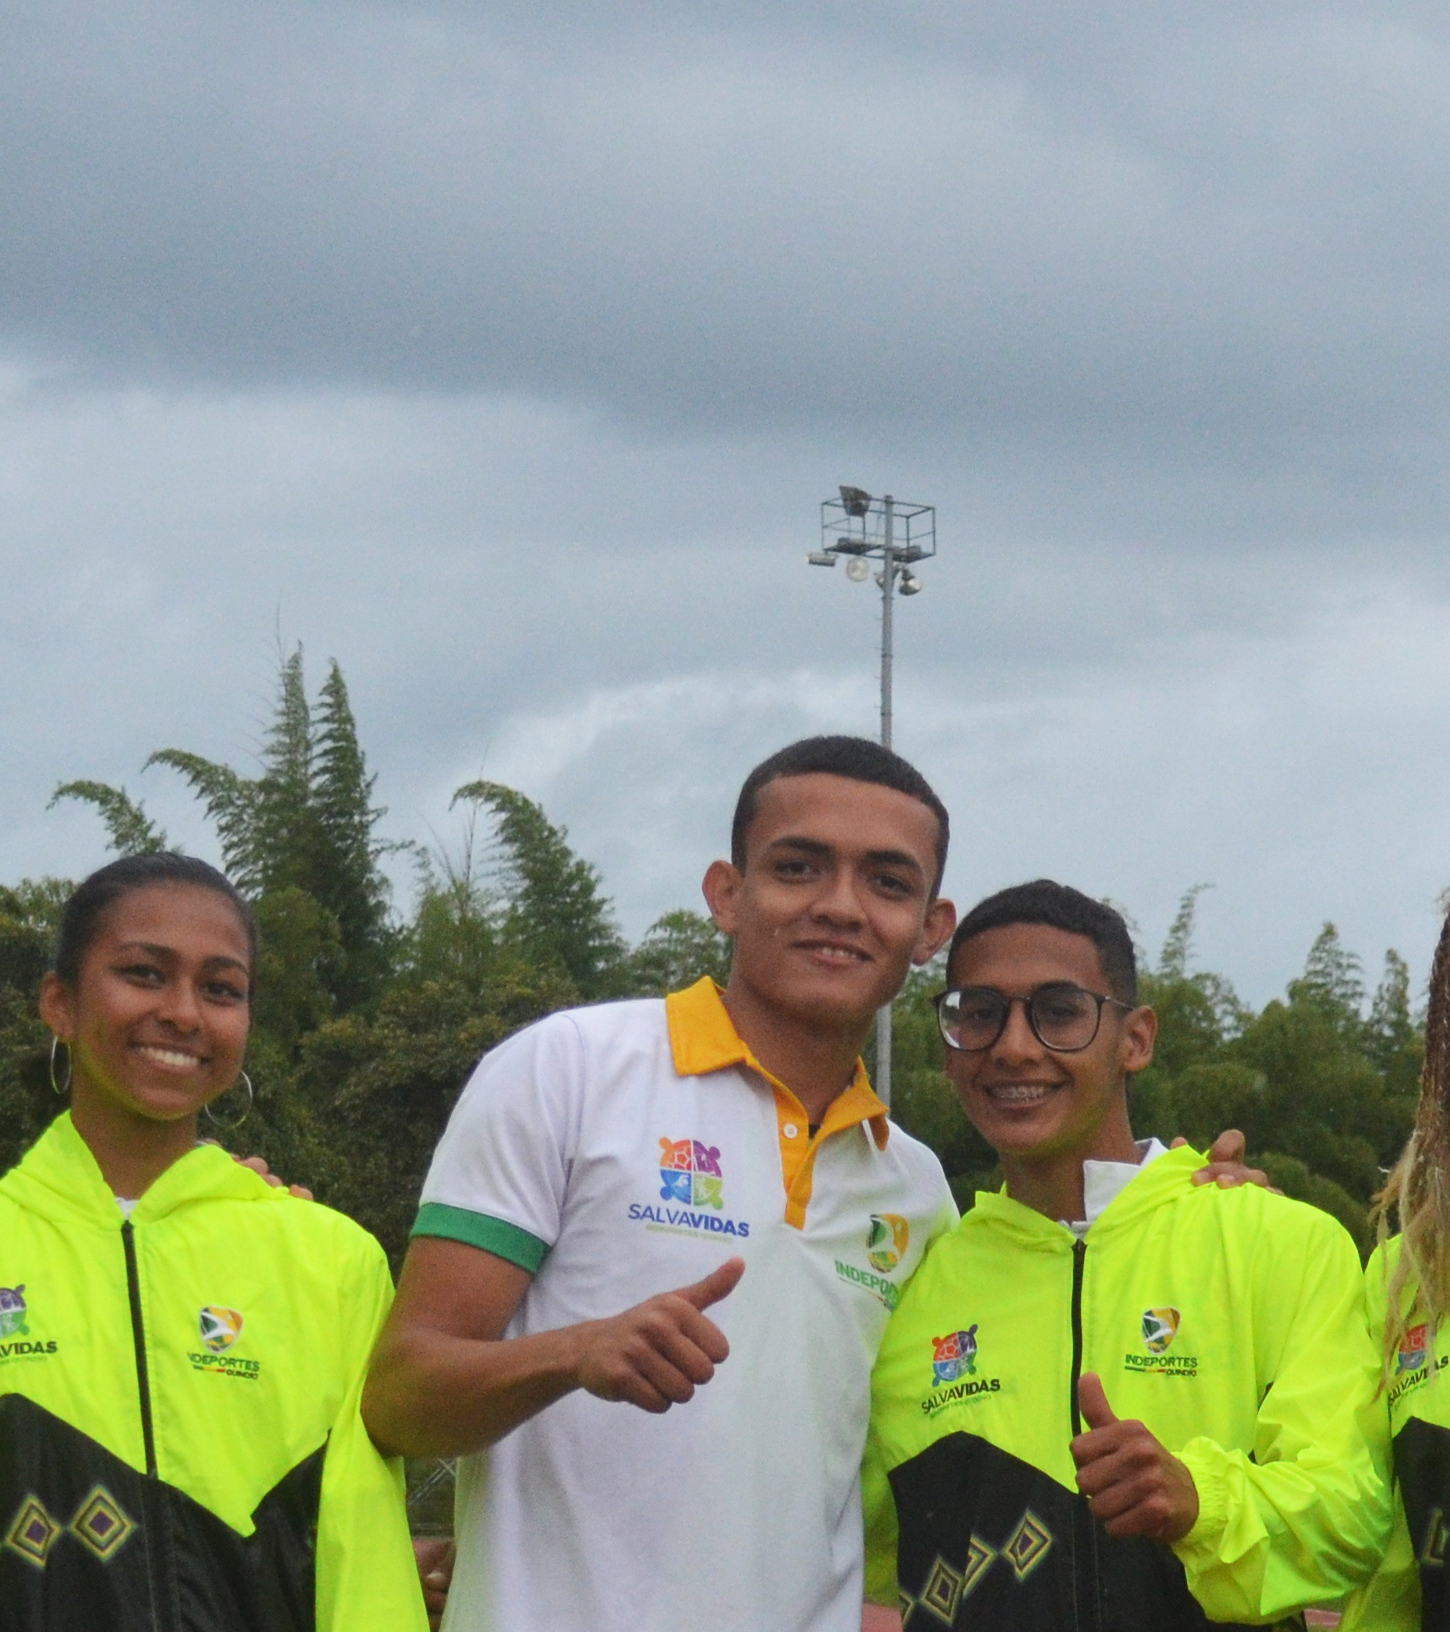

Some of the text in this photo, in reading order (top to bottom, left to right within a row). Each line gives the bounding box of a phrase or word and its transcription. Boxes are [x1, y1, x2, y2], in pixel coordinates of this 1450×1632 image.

[628, 1203, 750, 1237] SALVAVIDAS
[834, 1259, 899, 1296] INDEPO
[1125, 1353, 1198, 1369] INDEPORTES
[921, 1378, 1001, 1415] SALVAVIDAS
